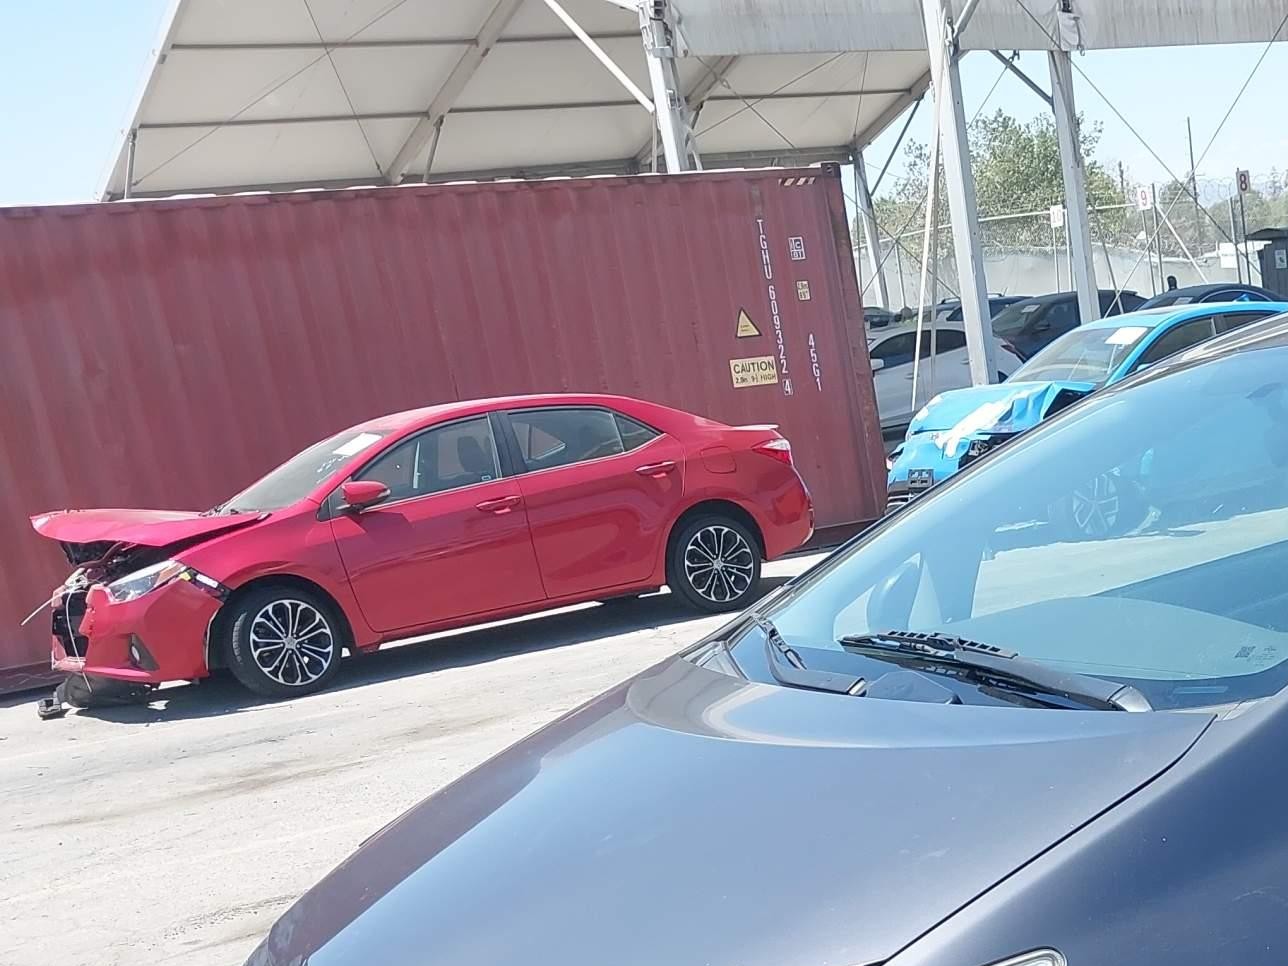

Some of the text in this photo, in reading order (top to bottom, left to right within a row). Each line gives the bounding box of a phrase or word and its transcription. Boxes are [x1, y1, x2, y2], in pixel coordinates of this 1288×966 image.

[1238, 173, 1248, 192] 8
[1140, 190, 1148, 206] 9
[756, 219, 772, 280] TGHU
[768, 284, 788, 374] 609322
[733, 360, 775, 375] CAUTION
[808, 333, 822, 392] 45G1
